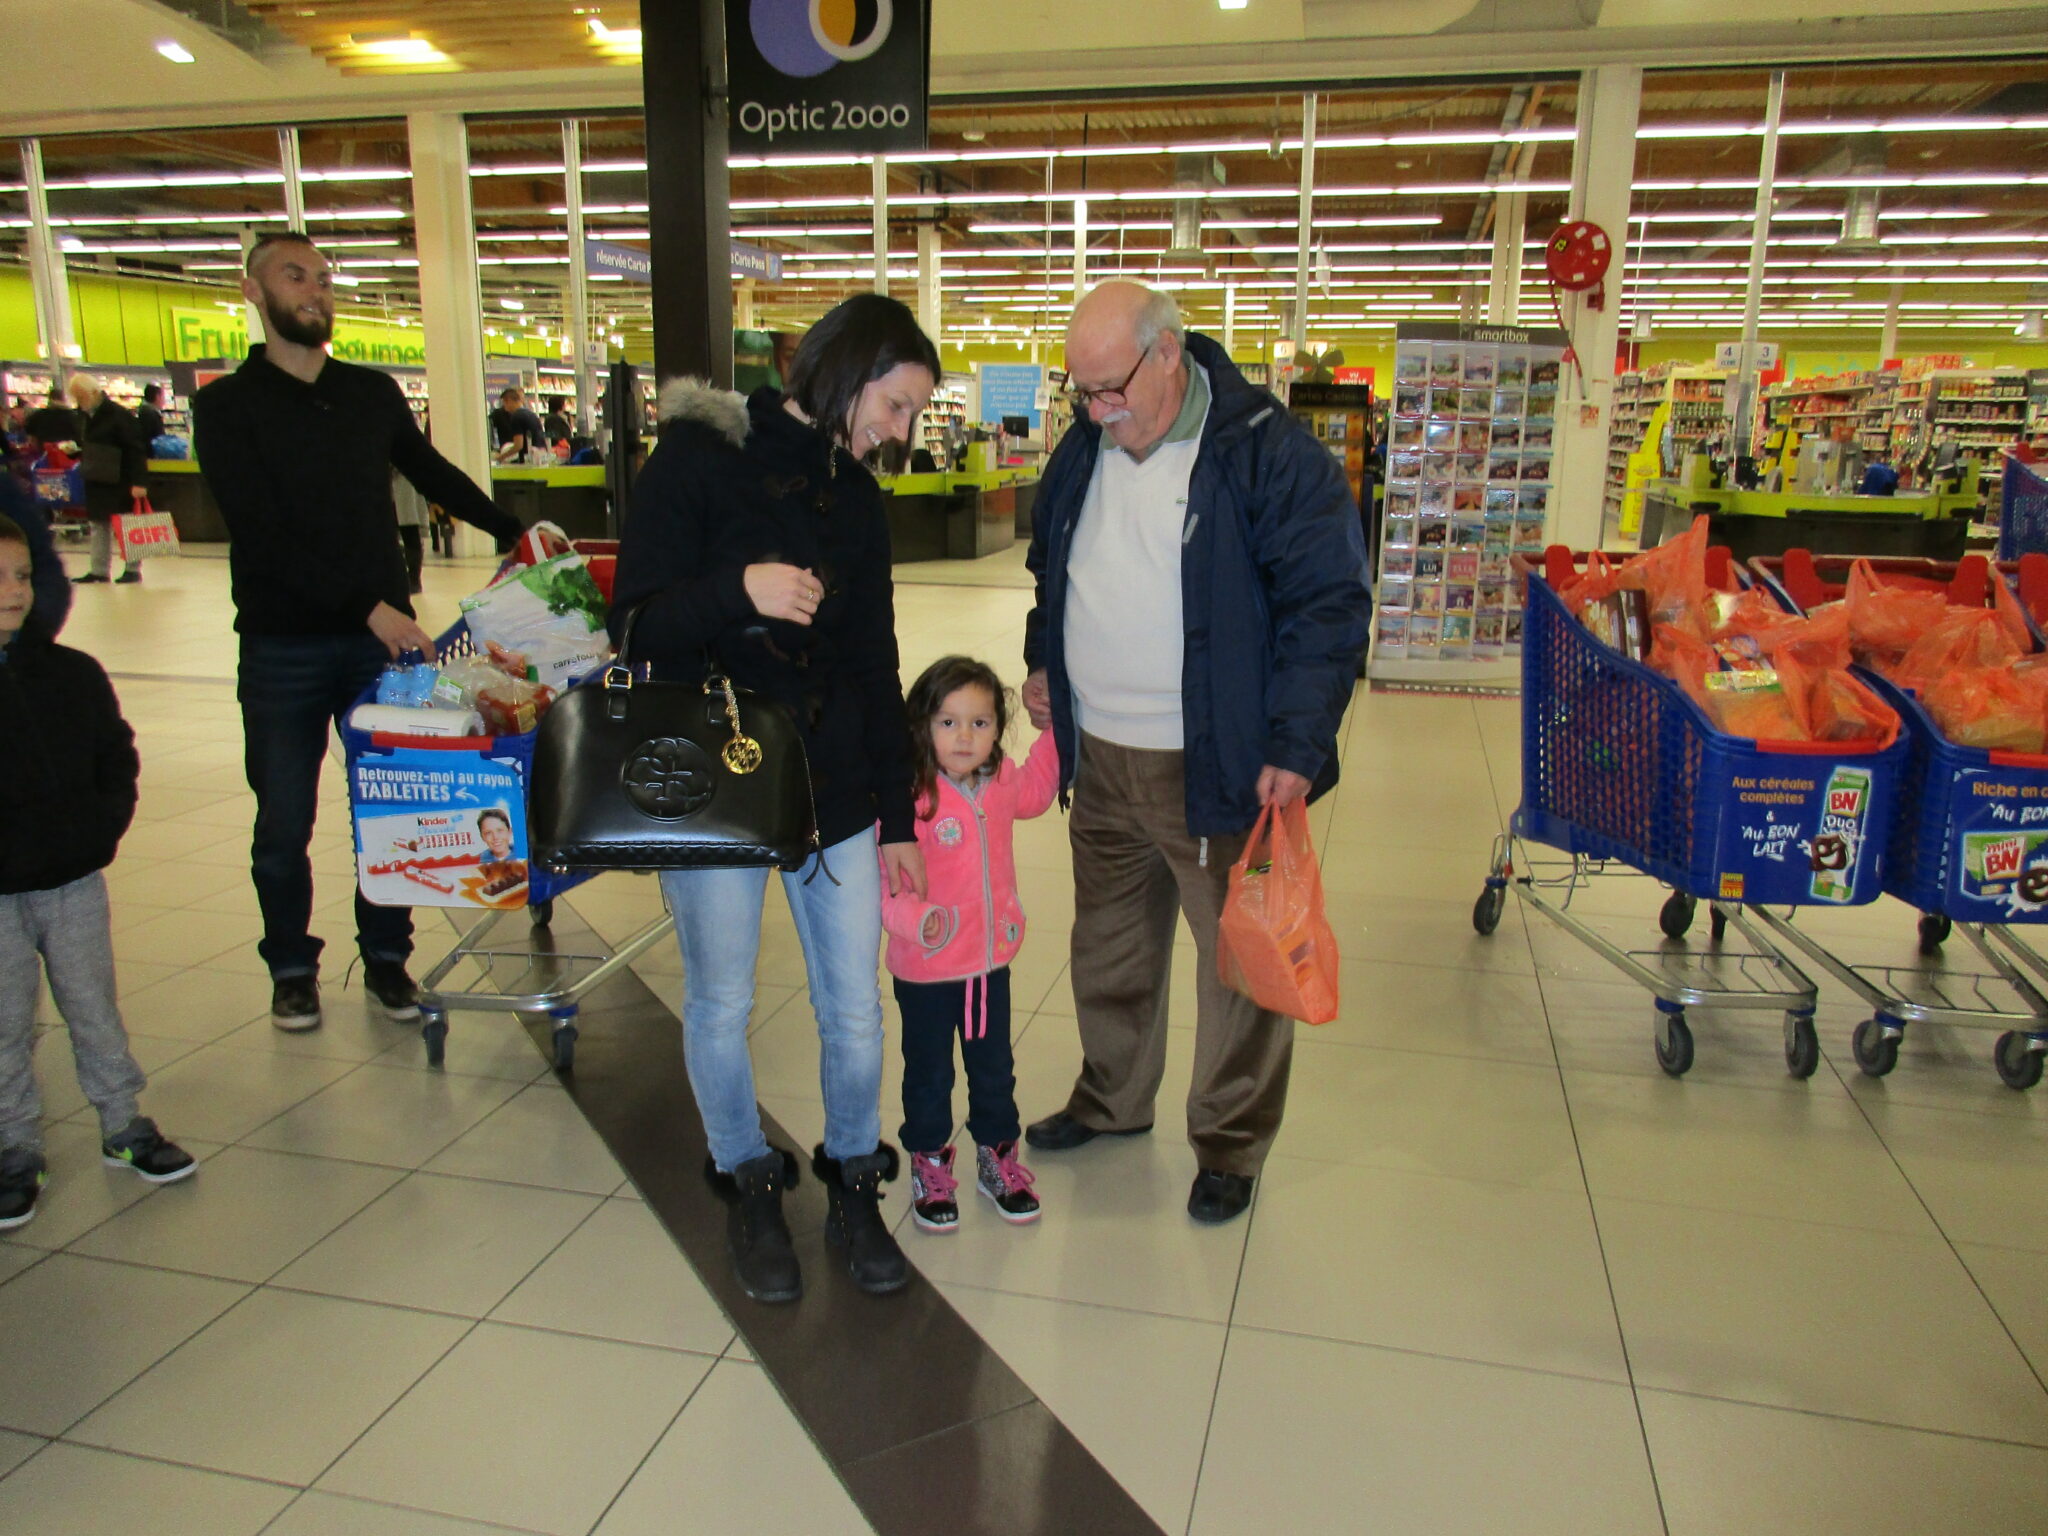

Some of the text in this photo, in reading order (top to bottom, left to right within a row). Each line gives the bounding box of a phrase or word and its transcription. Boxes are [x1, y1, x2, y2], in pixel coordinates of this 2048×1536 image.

[739, 100, 910, 142] Optic 2000
[596, 249, 627, 269] réservée
[628, 256, 647, 273] Carte
[179, 315, 248, 360] Frui
[331, 328, 425, 362] égume
[1473, 328, 1529, 344] smartbox
[1724, 346, 1732, 357] 4
[1762, 346, 1770, 358] 3
[358, 767, 513, 788] Retrouvez-moi au rayon
[1732, 776, 1815, 791] Aux céréales
[358, 781, 450, 802] TABLETTES
[1739, 791, 1805, 805] complètes
[1973, 781, 2018, 798] Riche
[2021, 786, 2038, 798] en
[1830, 791, 1859, 812] BN
[1766, 810, 1774, 823] &
[1752, 839, 1787, 858] LAIT
[1985, 848, 2020, 875] BN
